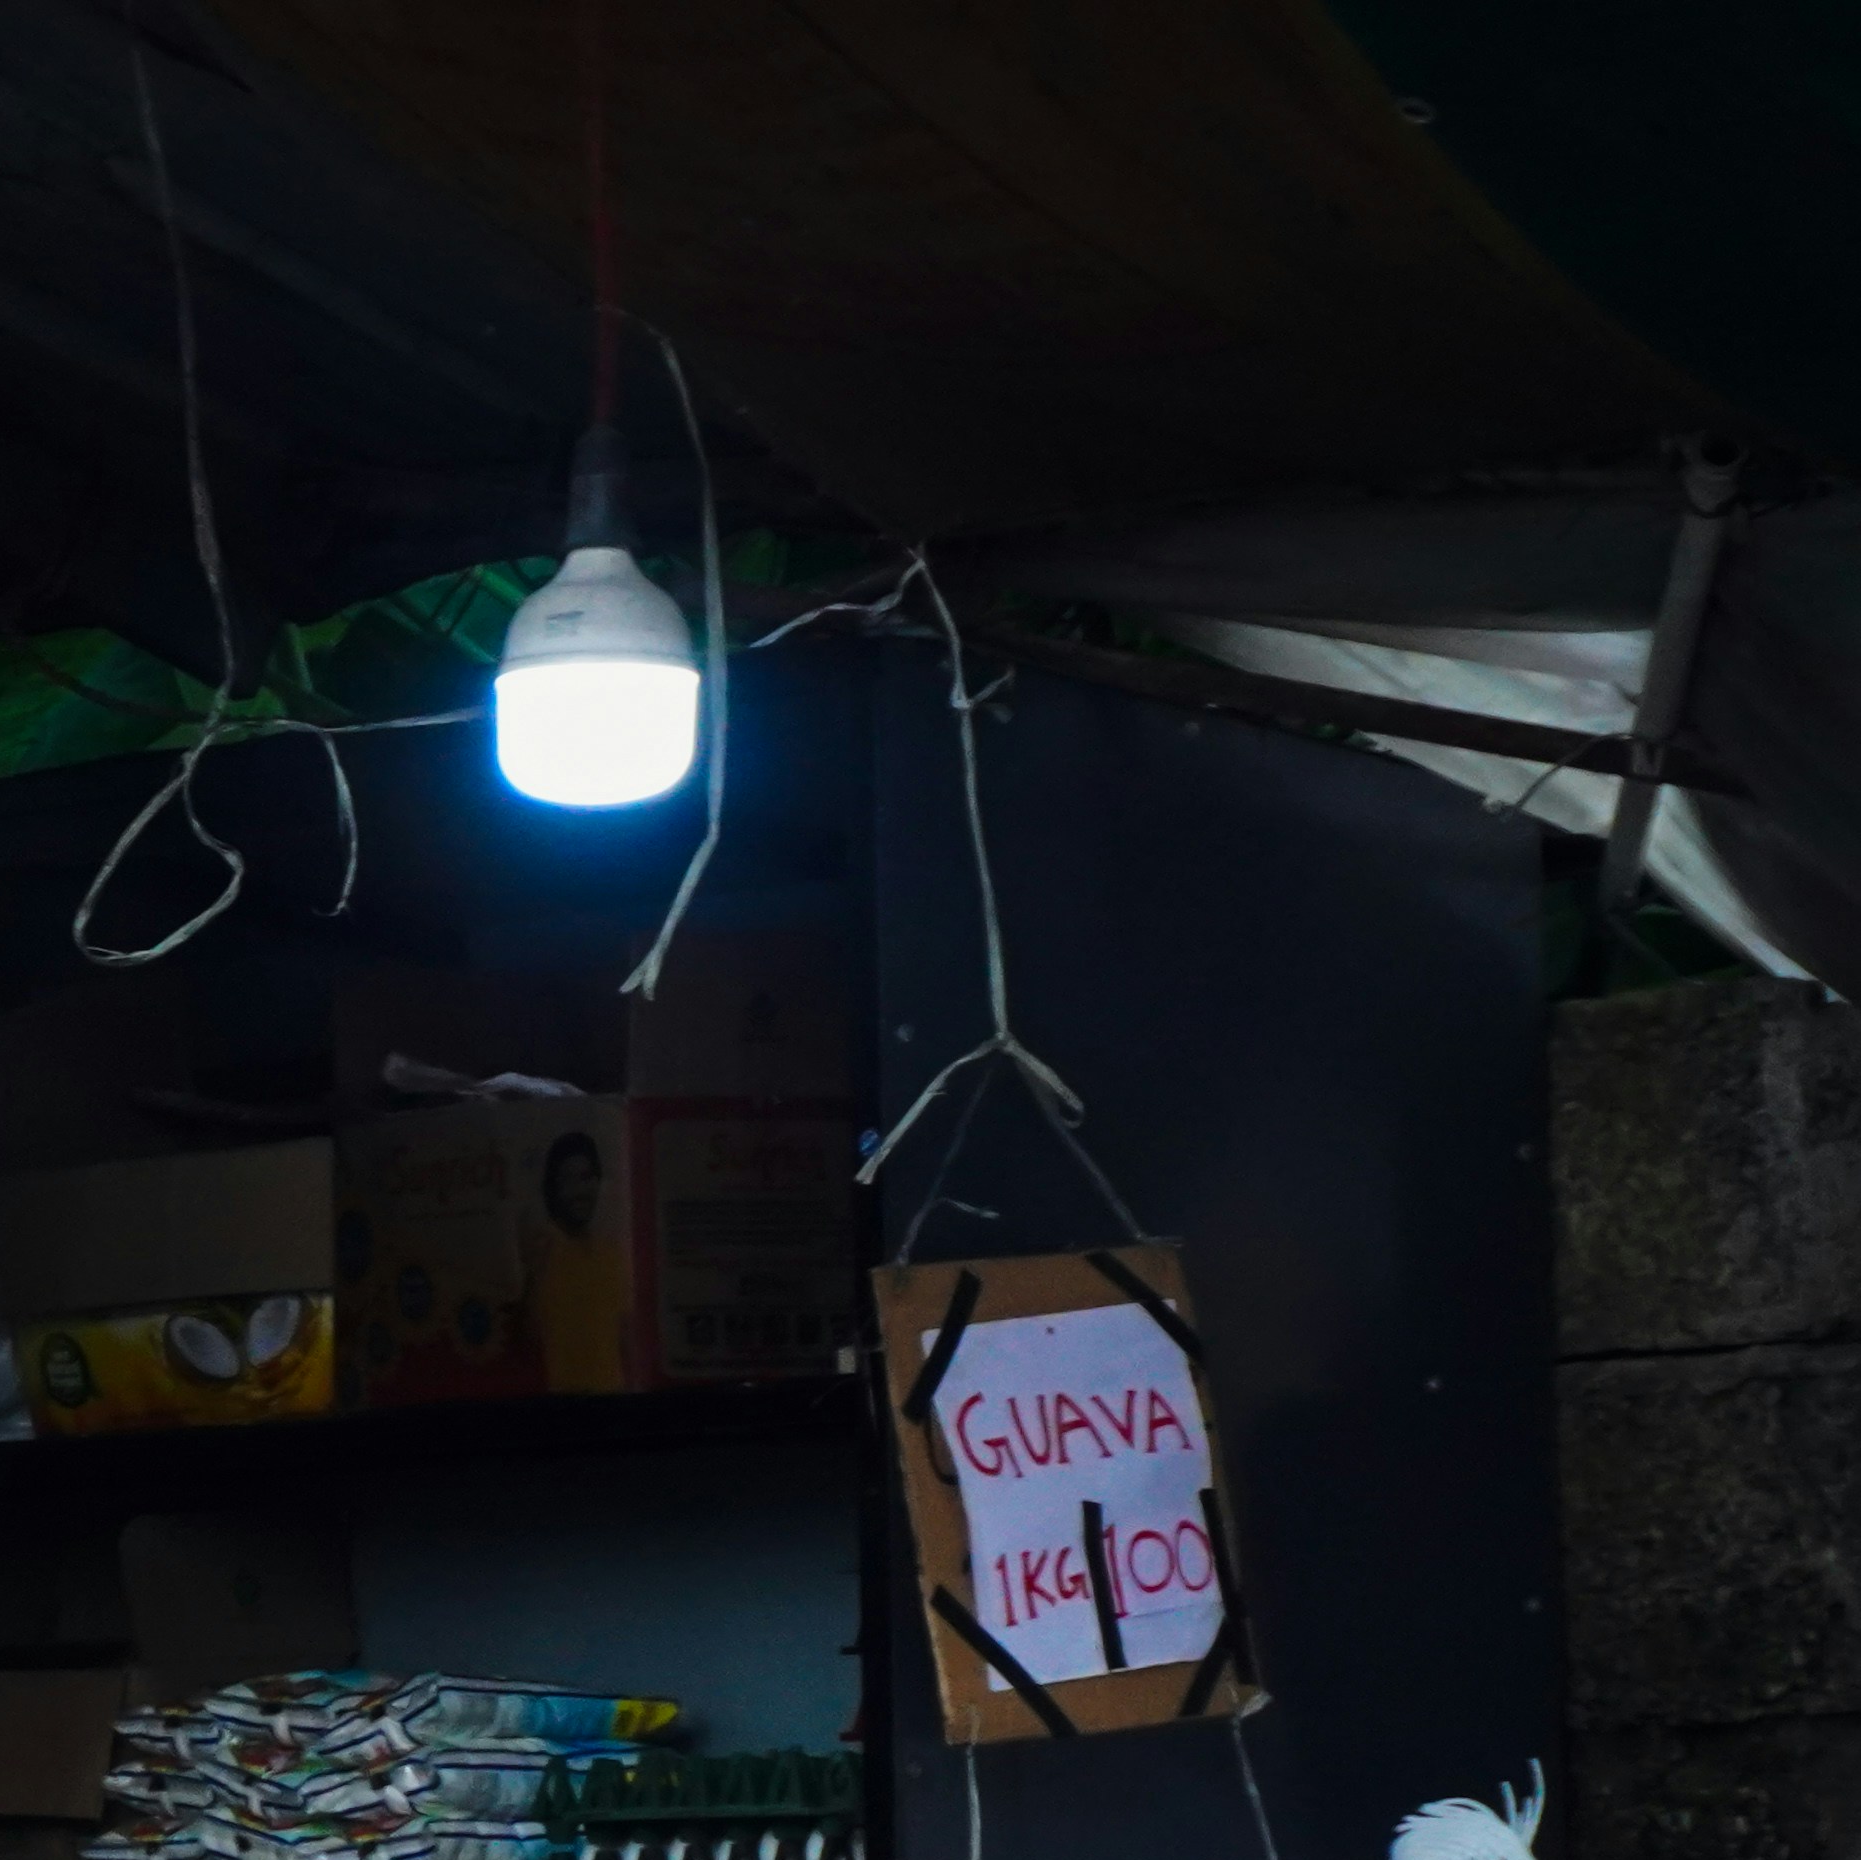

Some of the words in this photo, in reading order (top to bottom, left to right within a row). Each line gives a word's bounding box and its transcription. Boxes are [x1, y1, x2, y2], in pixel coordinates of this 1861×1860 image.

[955, 1389, 1192, 1478] GUAVA
[996, 1546, 1091, 1627] 1KG
[1102, 1520, 1215, 1619] 100
